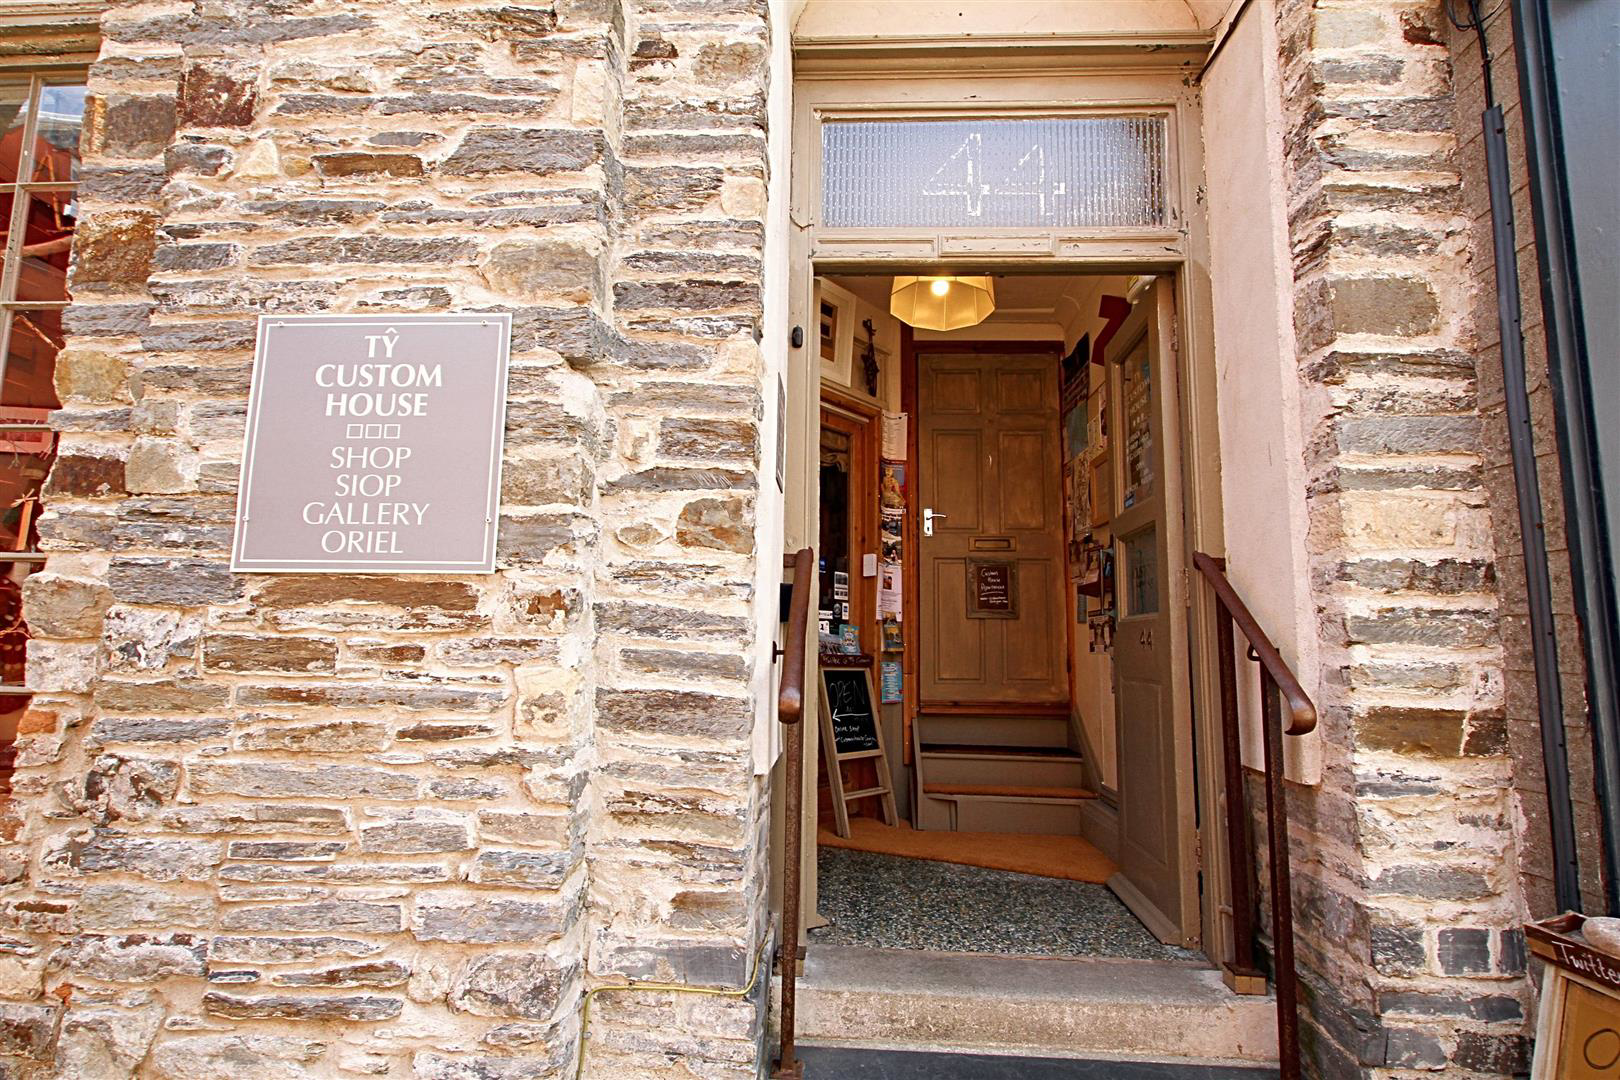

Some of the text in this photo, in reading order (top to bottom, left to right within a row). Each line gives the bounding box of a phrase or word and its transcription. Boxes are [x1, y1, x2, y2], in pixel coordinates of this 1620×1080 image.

[923, 133, 1066, 216] 44
[315, 363, 443, 387] CUSTOM
[325, 393, 429, 417] HOUSE
[330, 446, 412, 469] SHOP
[335, 474, 402, 497] SIOP
[302, 502, 430, 525] GALLERY
[321, 530, 404, 554] ORIEL
[1140, 628, 1153, 650] 44
